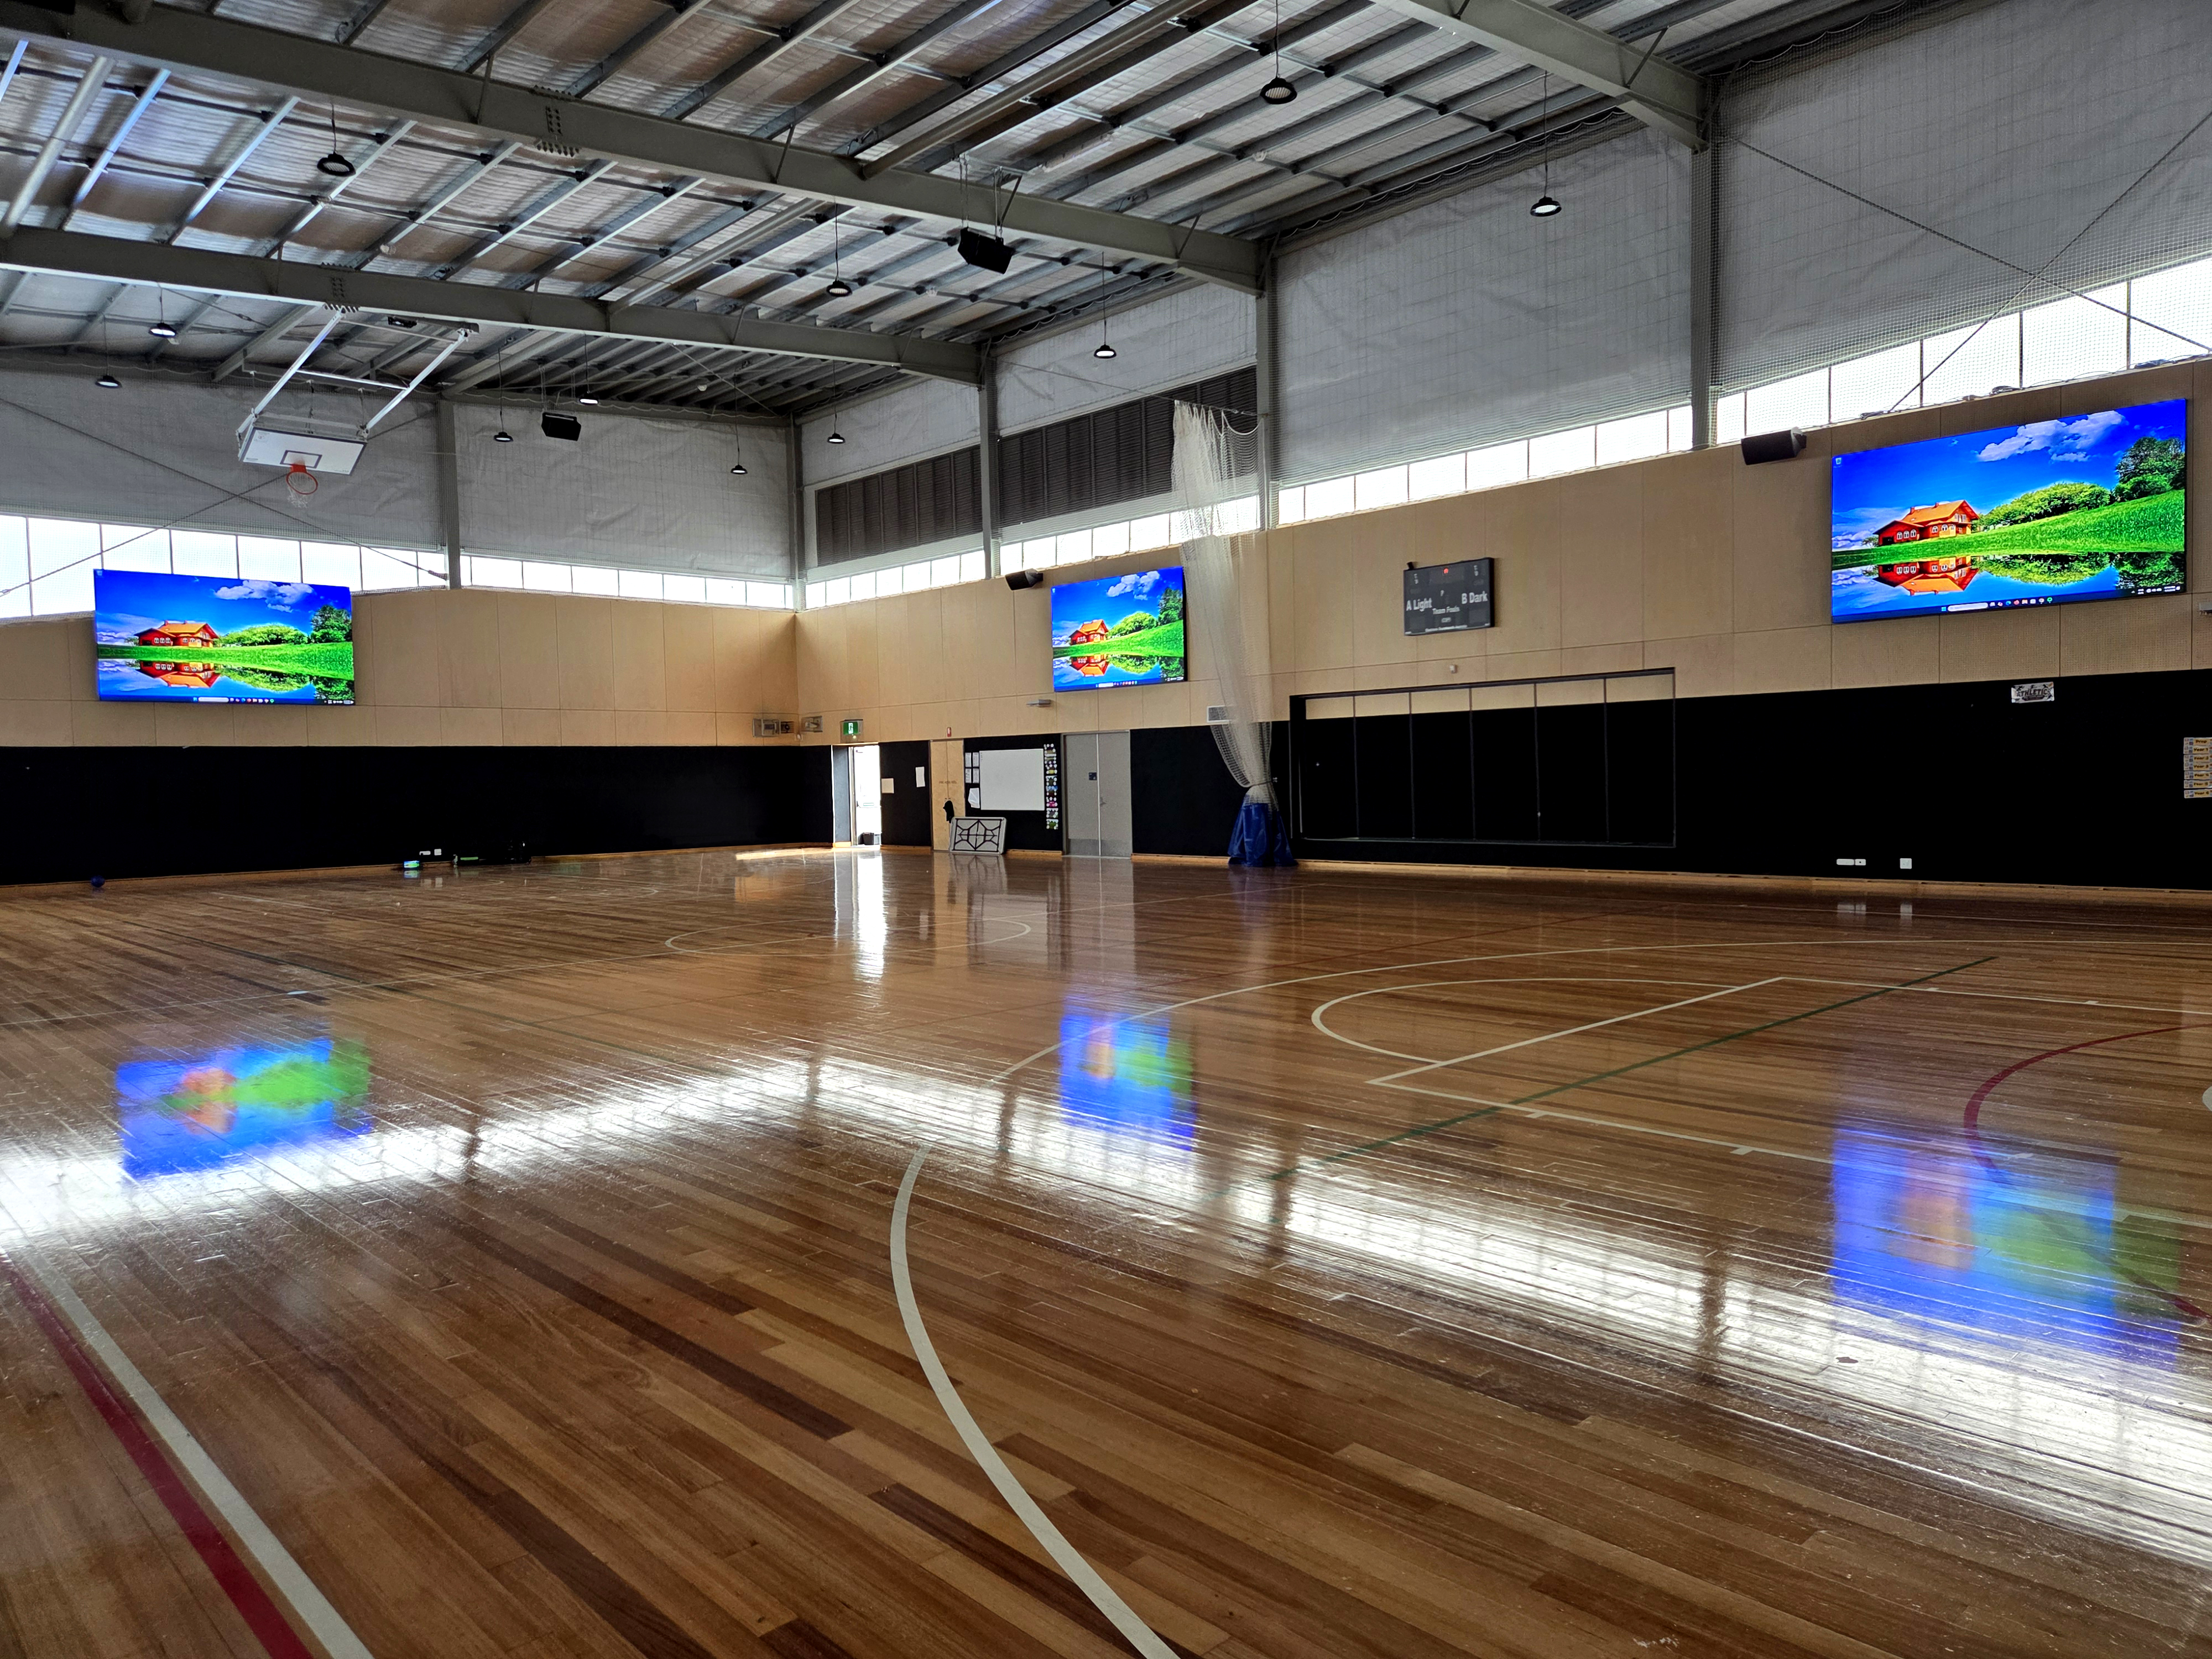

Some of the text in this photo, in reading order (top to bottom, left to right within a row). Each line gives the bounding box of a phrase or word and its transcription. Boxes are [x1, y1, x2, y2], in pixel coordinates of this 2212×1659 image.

[1462, 591, 1488, 604] B Dark
[1406, 597, 1432, 612] A Light
[2017, 688, 2051, 697] ATHLETICS
